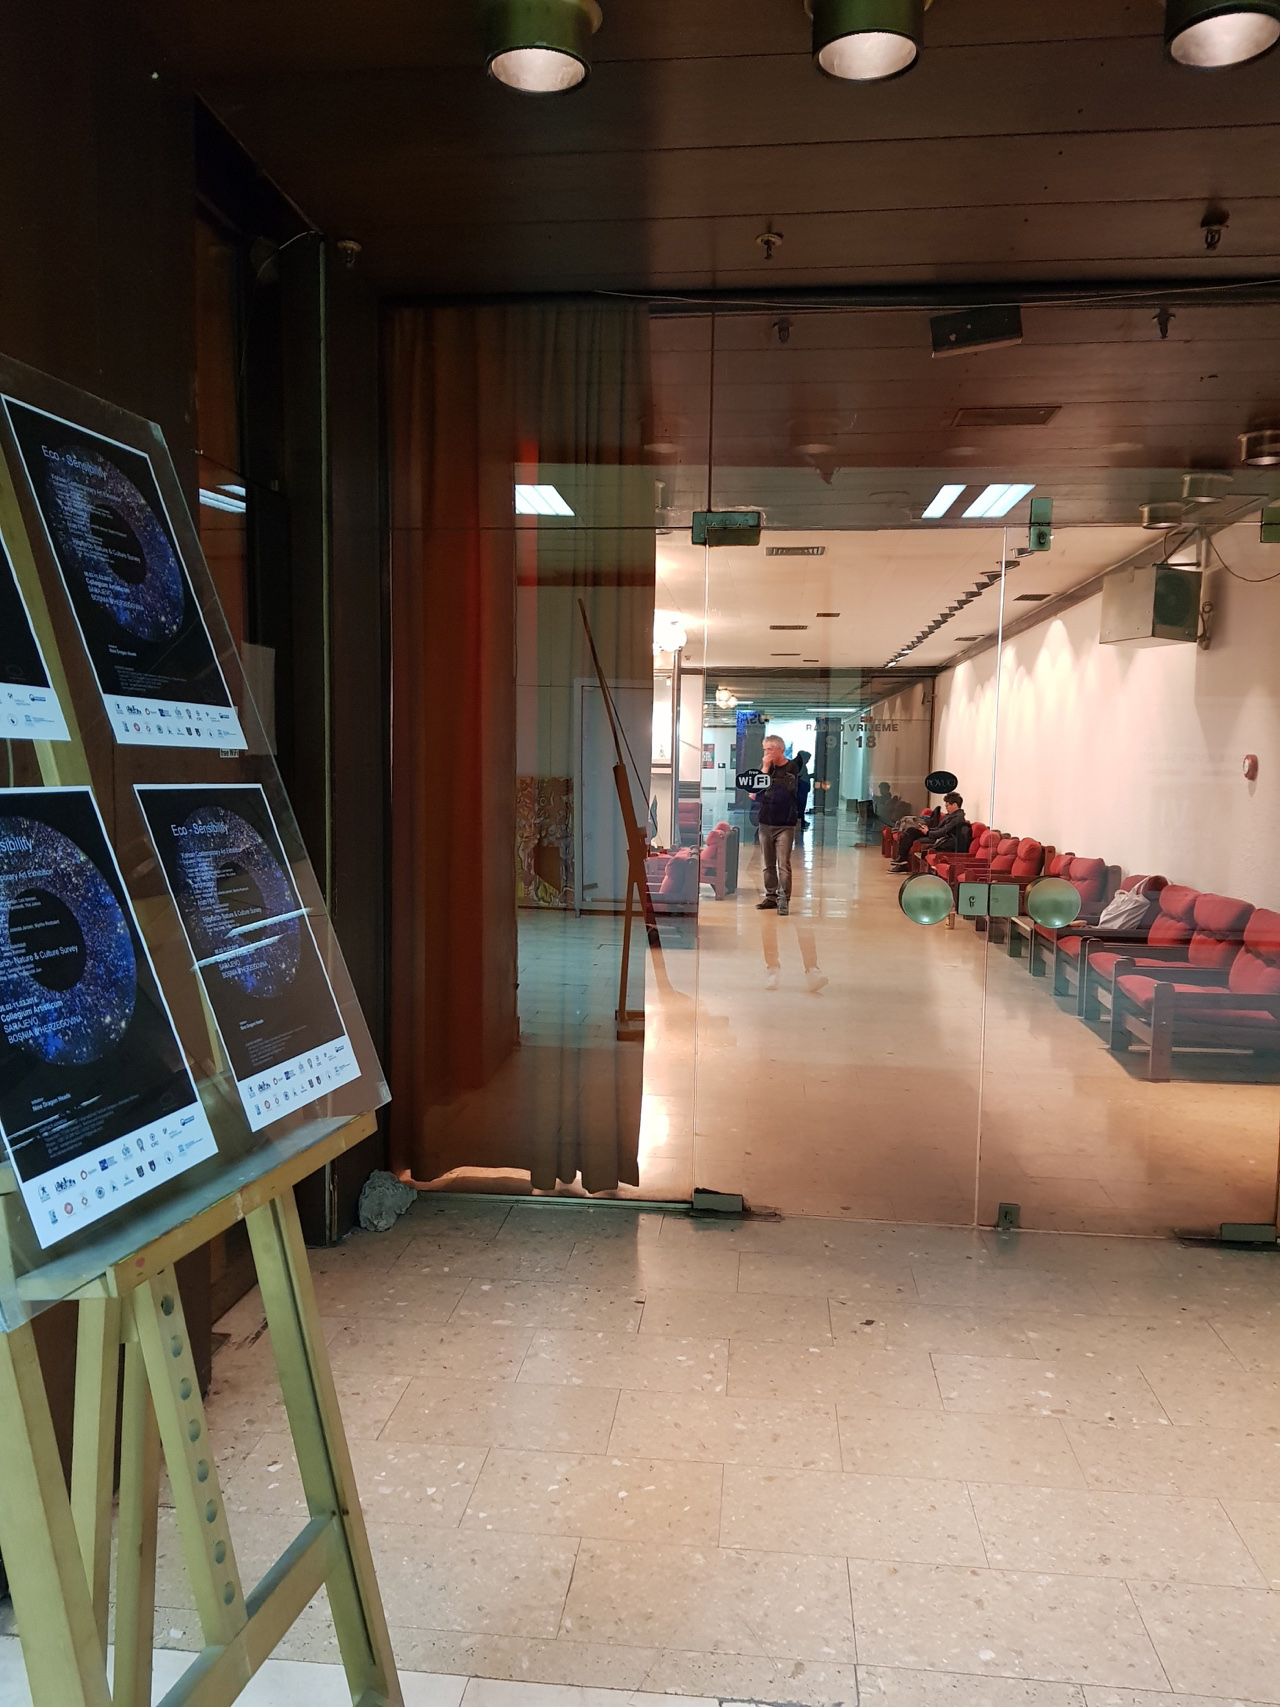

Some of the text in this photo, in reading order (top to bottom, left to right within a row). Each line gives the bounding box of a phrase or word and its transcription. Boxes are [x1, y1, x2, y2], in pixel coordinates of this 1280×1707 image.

[41, 445, 60, 461] Eco
[848, 724, 899, 732] VRIJEME
[826, 736, 838, 749] 9
[855, 736, 877, 749] 18
[171, 824, 188, 836] Eco
[192, 822, 229, 835] Sensibility
[1, 1001, 63, 1022] Collegium Artisticum
[4, 1016, 39, 1033] SARAJEVO
[8, 1029, 34, 1044] BOSNIA
[40, 1015, 83, 1034] HERZEGOVINA
